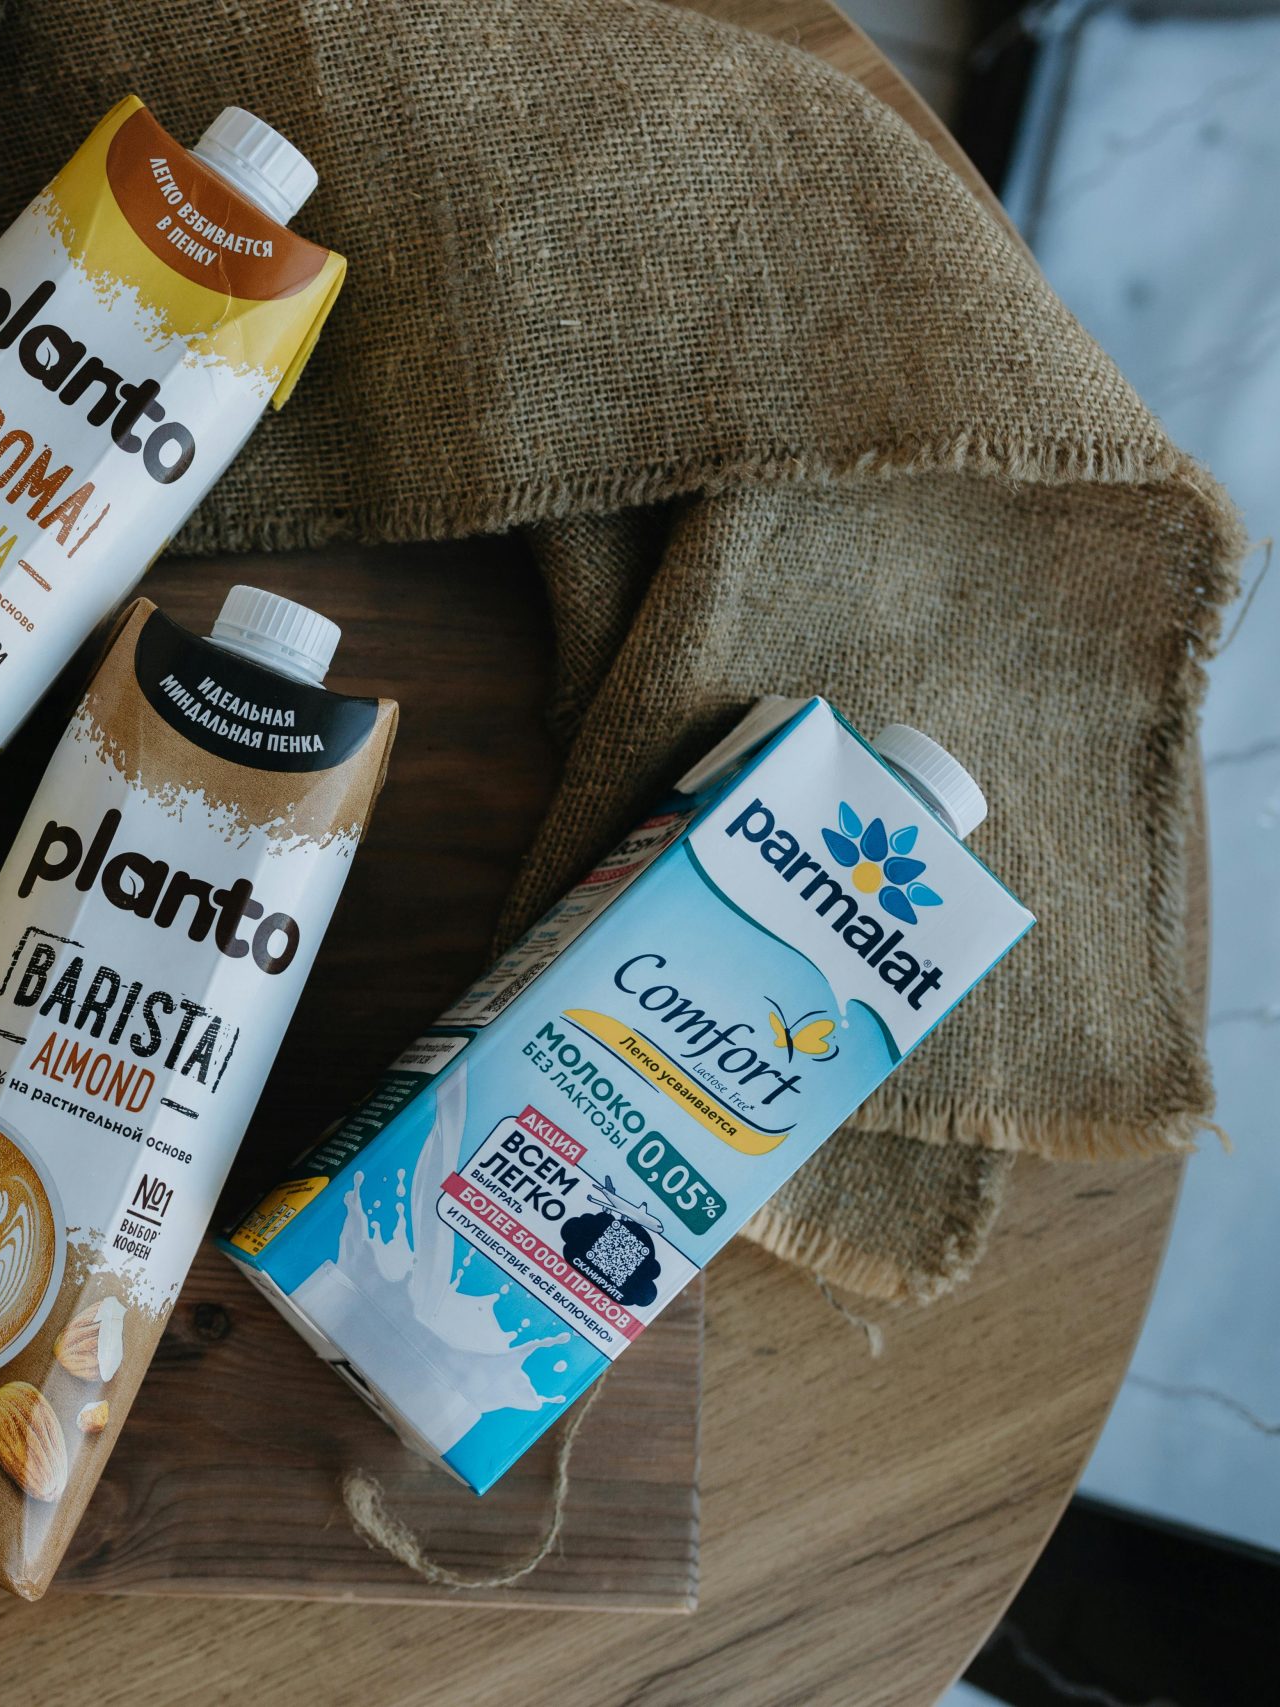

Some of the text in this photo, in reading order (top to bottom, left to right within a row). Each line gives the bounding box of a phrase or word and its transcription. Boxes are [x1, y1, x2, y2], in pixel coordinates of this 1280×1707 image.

[149, 158, 273, 257] ЛЕГКО ВЗБИВАЕТСЯ
[156, 216, 218, 266] В ПЕНКУ
[159, 674, 324, 753] МИНДАЛЬНАЯ ПЕНКА
[197, 676, 295, 727] ИДЕАЛЬНАЯ
[18, 808, 300, 975] planto
[724, 798, 944, 1011] parmalat
[13, 942, 223, 1085] BARISTA
[614, 954, 802, 1105] Comfort
[29, 1031, 156, 1113] ALMOND
[522, 1041, 628, 1150] БЕЗ ЛАКТОЗЫ
[619, 1036, 738, 1136] Легко усваивается
[693, 1062, 728, 1094] Lactose
[9, 1077, 28, 1094] на
[31, 1087, 142, 1143] растительной
[146, 1136, 192, 1164] основе
[521, 1113, 581, 1162] АКЦИЯ
[535, 1021, 645, 1134] МОЛОКО
[636, 1139, 721, 1220] 0,05%
[470, 1169, 523, 1214] ВЫИГРАТЬ
[478, 1152, 566, 1221] ЛЕГКО
[500, 1130, 580, 1196] ВСЕМ
[112, 1234, 152, 1261] КОФЕЕН
[446, 1206, 613, 1343] И ПУТЕШЕСТВИЕ «ВСЁ ВКЛЮЧЕНО»
[459, 1186, 630, 1329] БОЛЕЕ 50 000 ПРИЗОВ
[572, 1257, 625, 1301] СКАНИРУЙТЕ
